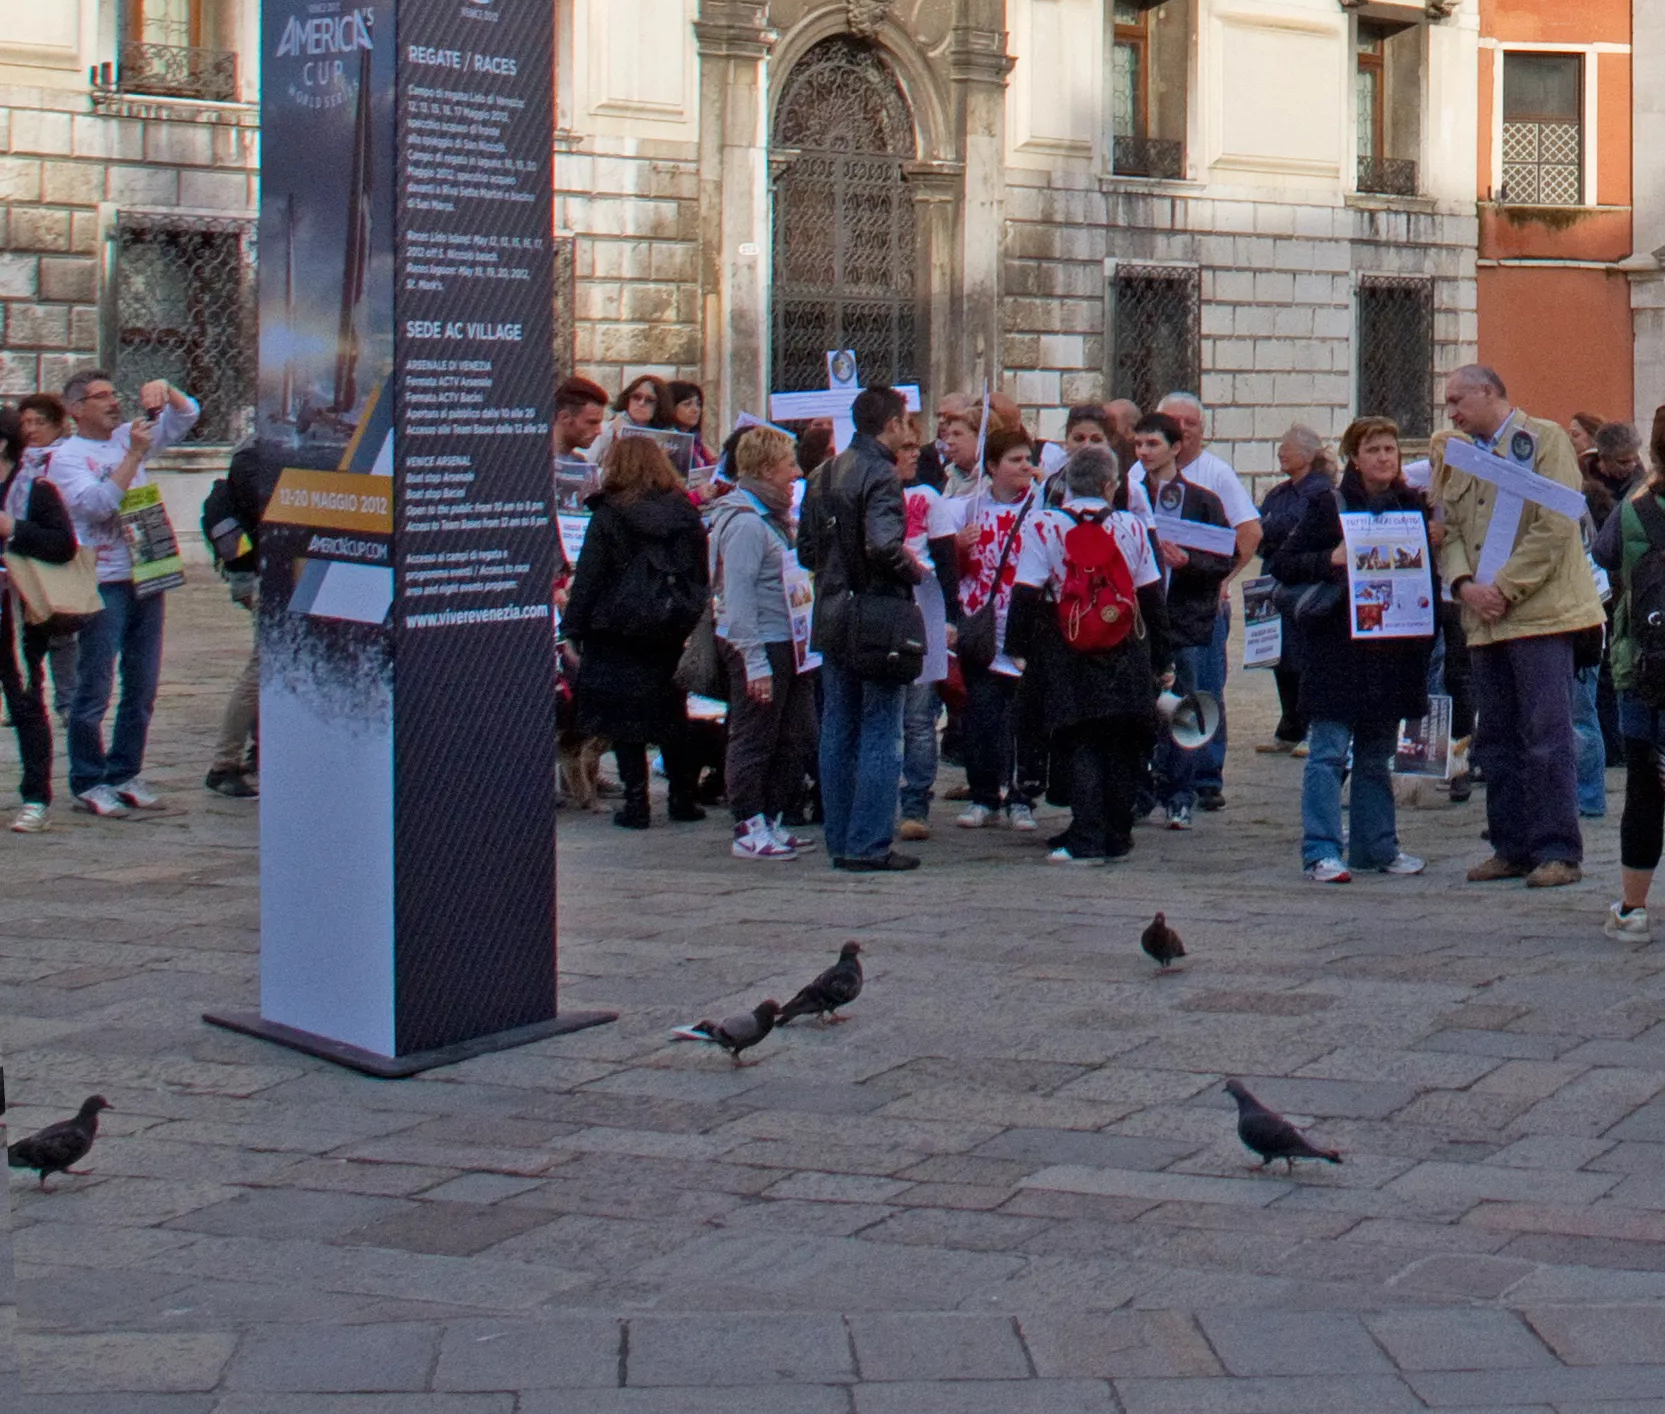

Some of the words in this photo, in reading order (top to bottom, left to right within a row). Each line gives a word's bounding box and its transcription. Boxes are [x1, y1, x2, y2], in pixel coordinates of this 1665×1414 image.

[304, 60, 344, 86] CUP
[409, 45, 461, 68] REGATE
[464, 52, 472, 72] /
[475, 54, 517, 76] RACES
[406, 320, 441, 338] SEDE
[445, 322, 462, 338] AC
[466, 323, 522, 340] VILLAGE
[280, 488, 308, 507] 12-20
[311, 491, 357, 511] MAGGIO
[361, 496, 387, 514] 2012
[406, 603, 548, 628] www.viverevenezia.com
